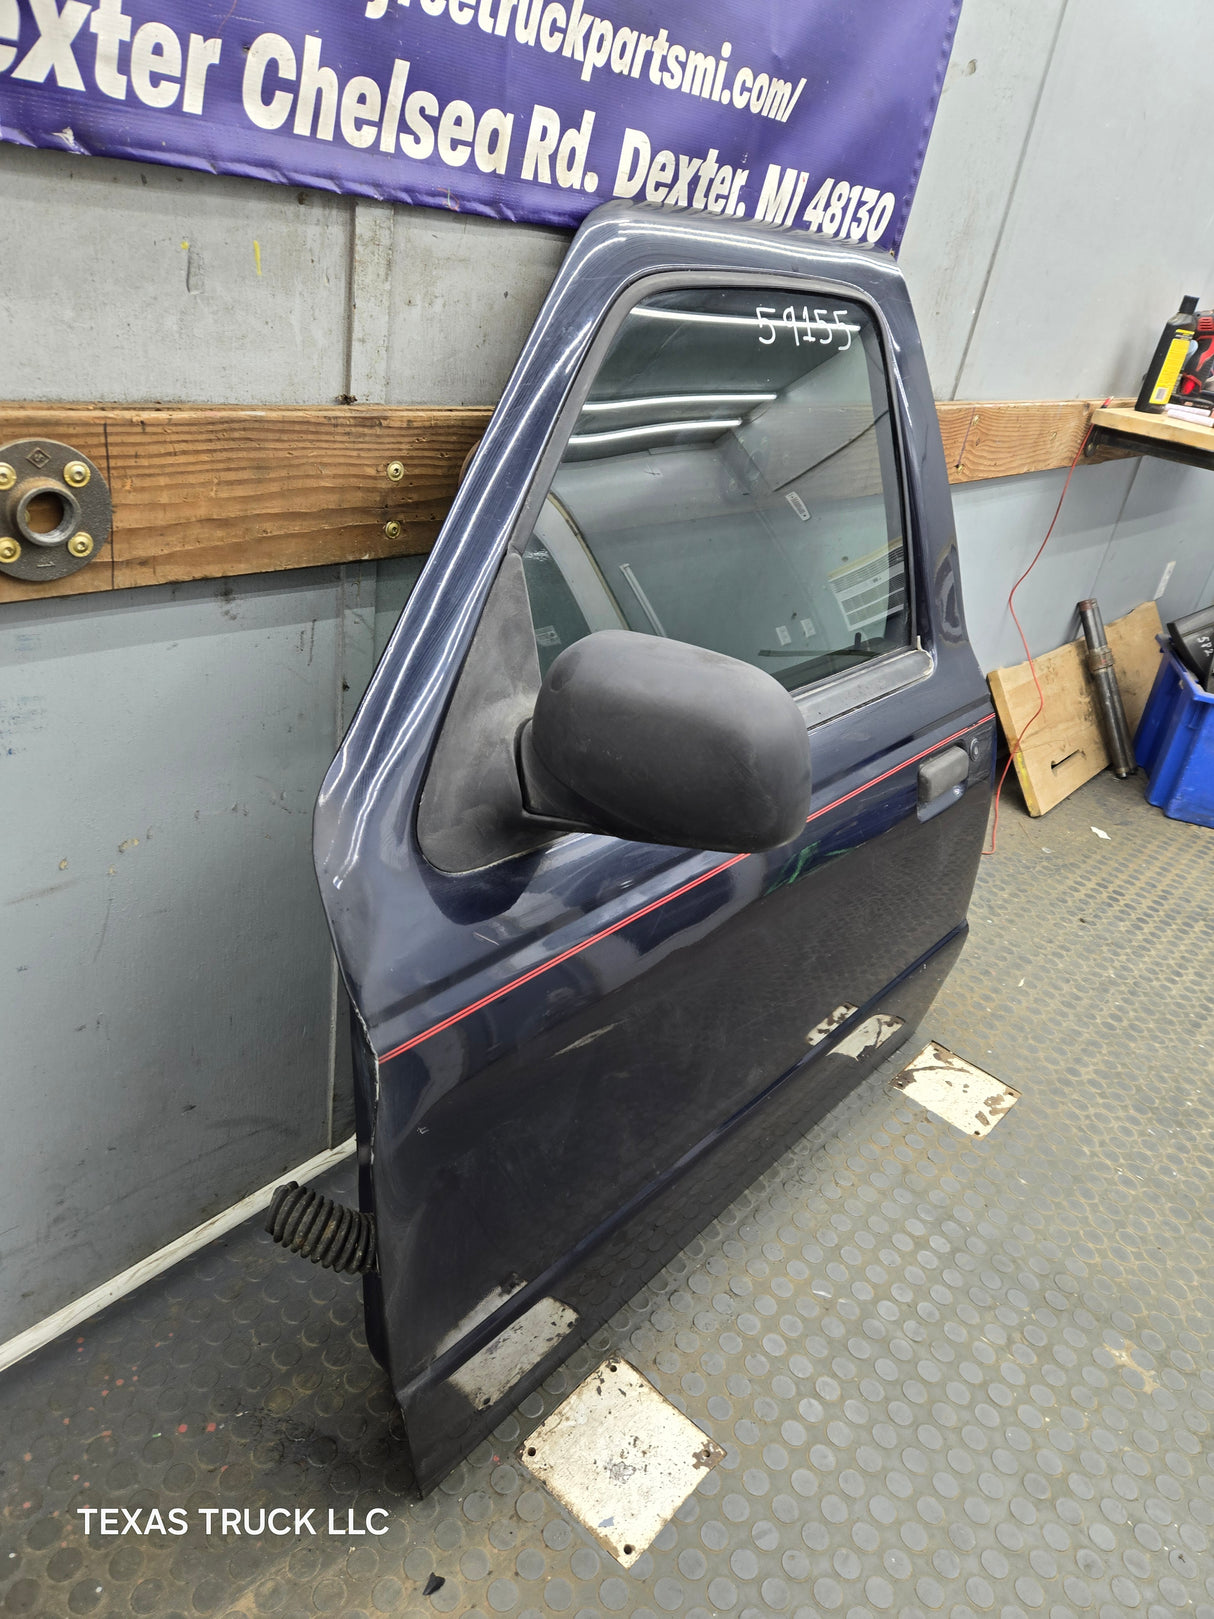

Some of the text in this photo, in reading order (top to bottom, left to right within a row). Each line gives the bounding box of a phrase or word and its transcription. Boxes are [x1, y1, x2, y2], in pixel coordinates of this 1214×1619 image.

[242, 32, 514, 174] Chelsea
[520, 104, 598, 193] Rd.
[753, 164, 810, 227] MI
[803, 178, 895, 243] 48130
[756, 306, 852, 350] 59155
